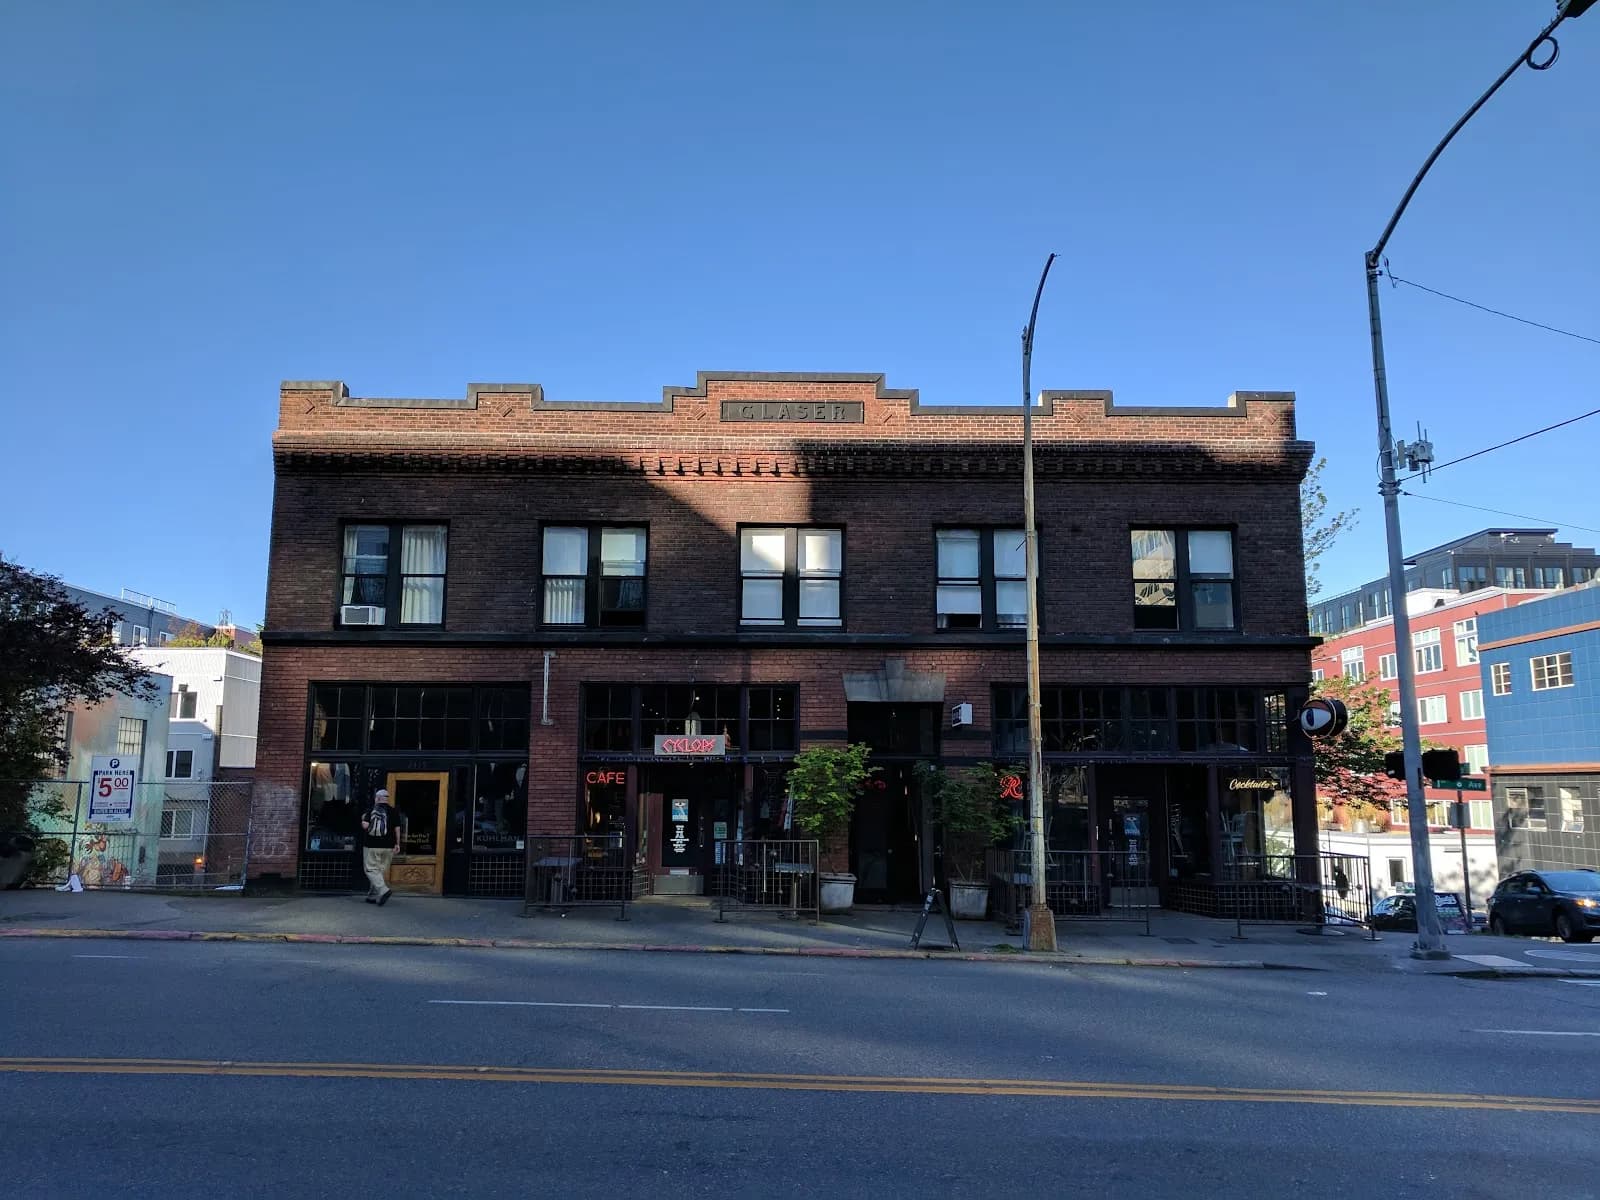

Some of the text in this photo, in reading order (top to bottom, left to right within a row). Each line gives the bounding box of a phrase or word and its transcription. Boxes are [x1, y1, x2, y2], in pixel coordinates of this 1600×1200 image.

[742, 403, 846, 420] GLASER
[662, 738, 716, 753] CYCLOPS
[586, 771, 625, 784] CAFE
[1229, 778, 1271, 790] Cocktails
[1000, 775, 1024, 799] R
